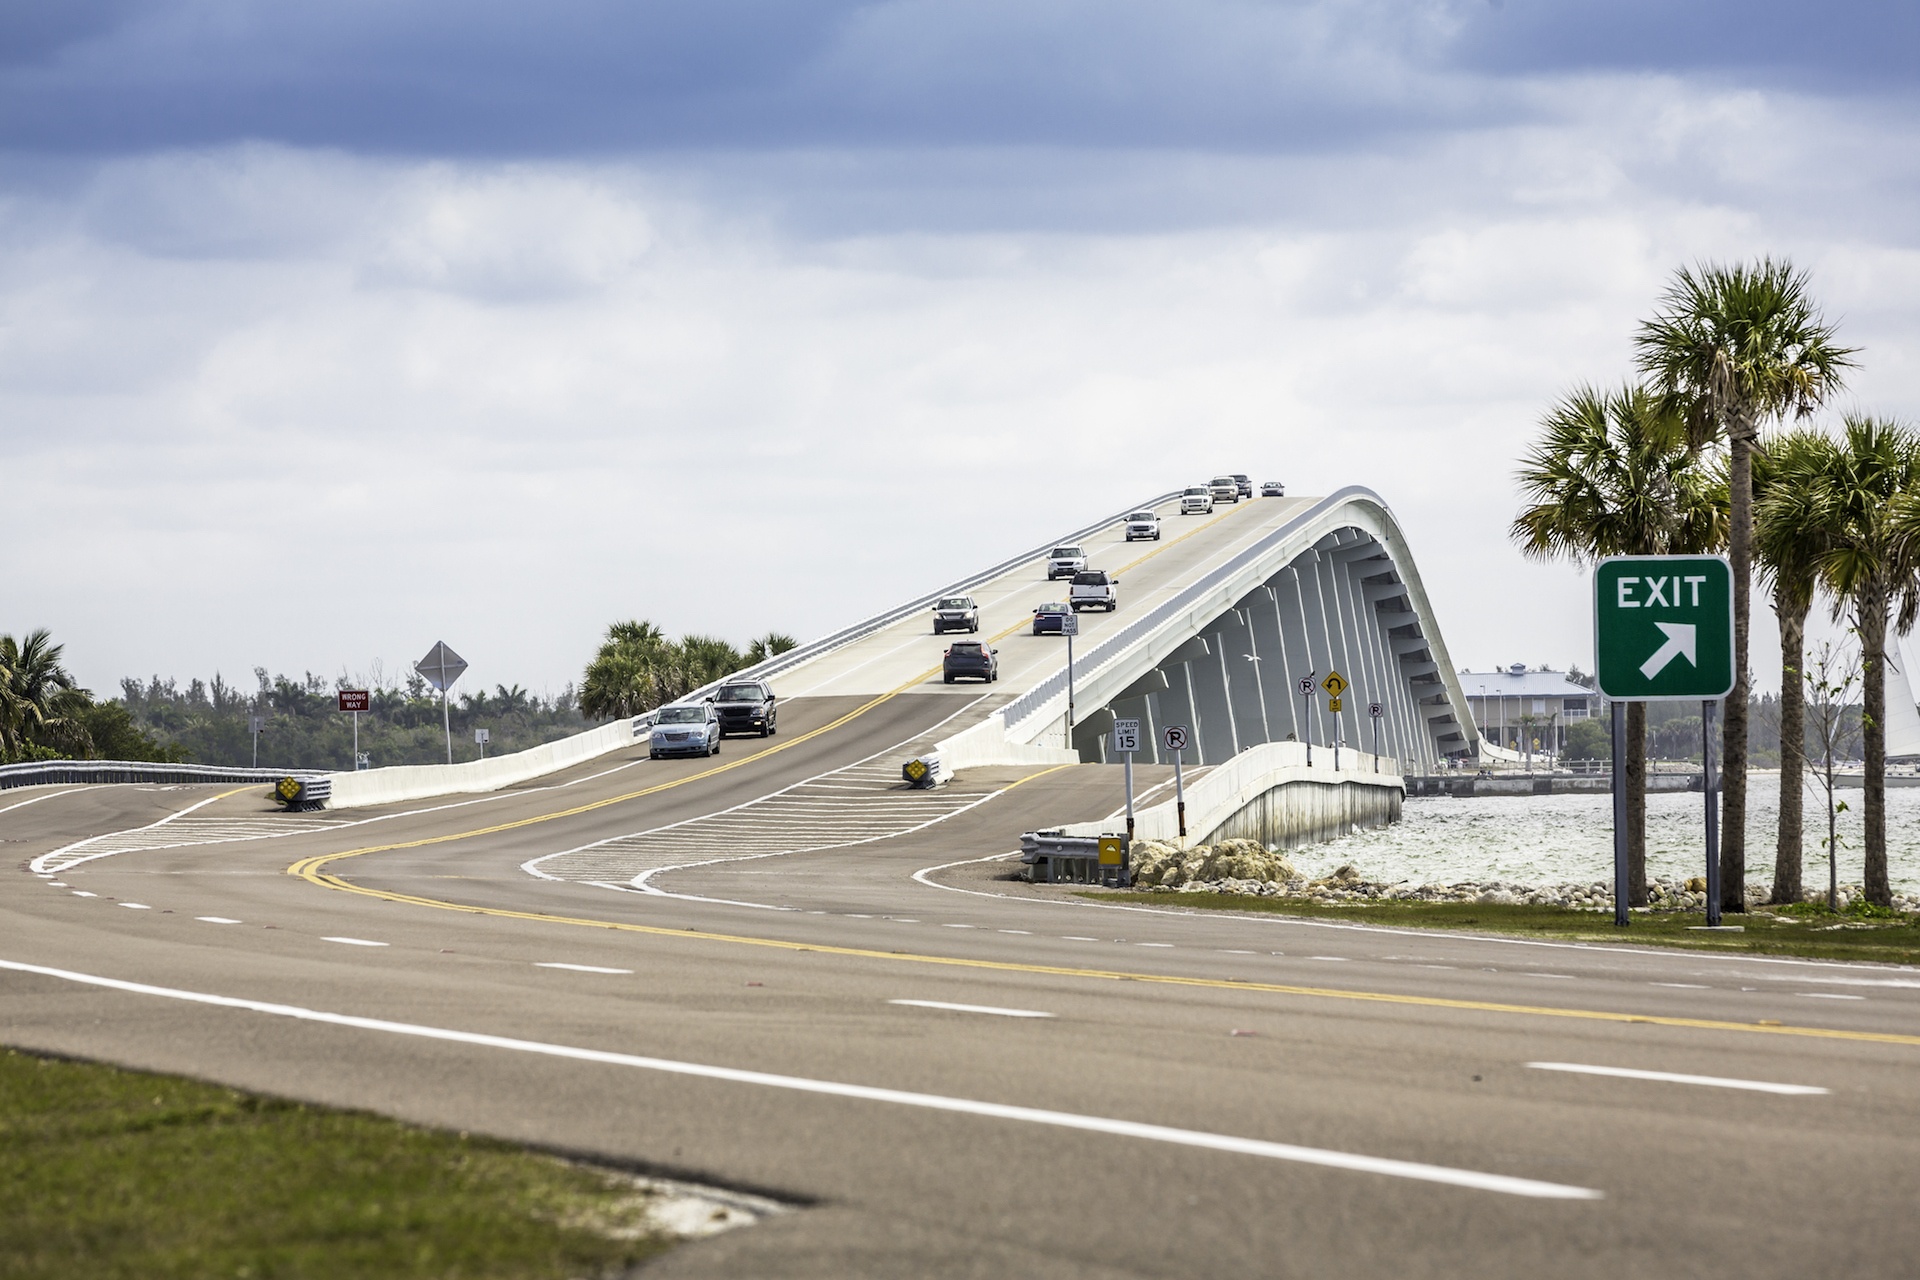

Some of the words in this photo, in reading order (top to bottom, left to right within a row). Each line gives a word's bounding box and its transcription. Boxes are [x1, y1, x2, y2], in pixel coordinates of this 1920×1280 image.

[1617, 575, 1707, 608] EXIT
[341, 693, 366, 701] WRONG
[346, 701, 361, 709] WAY
[1119, 736, 1135, 748] 15
